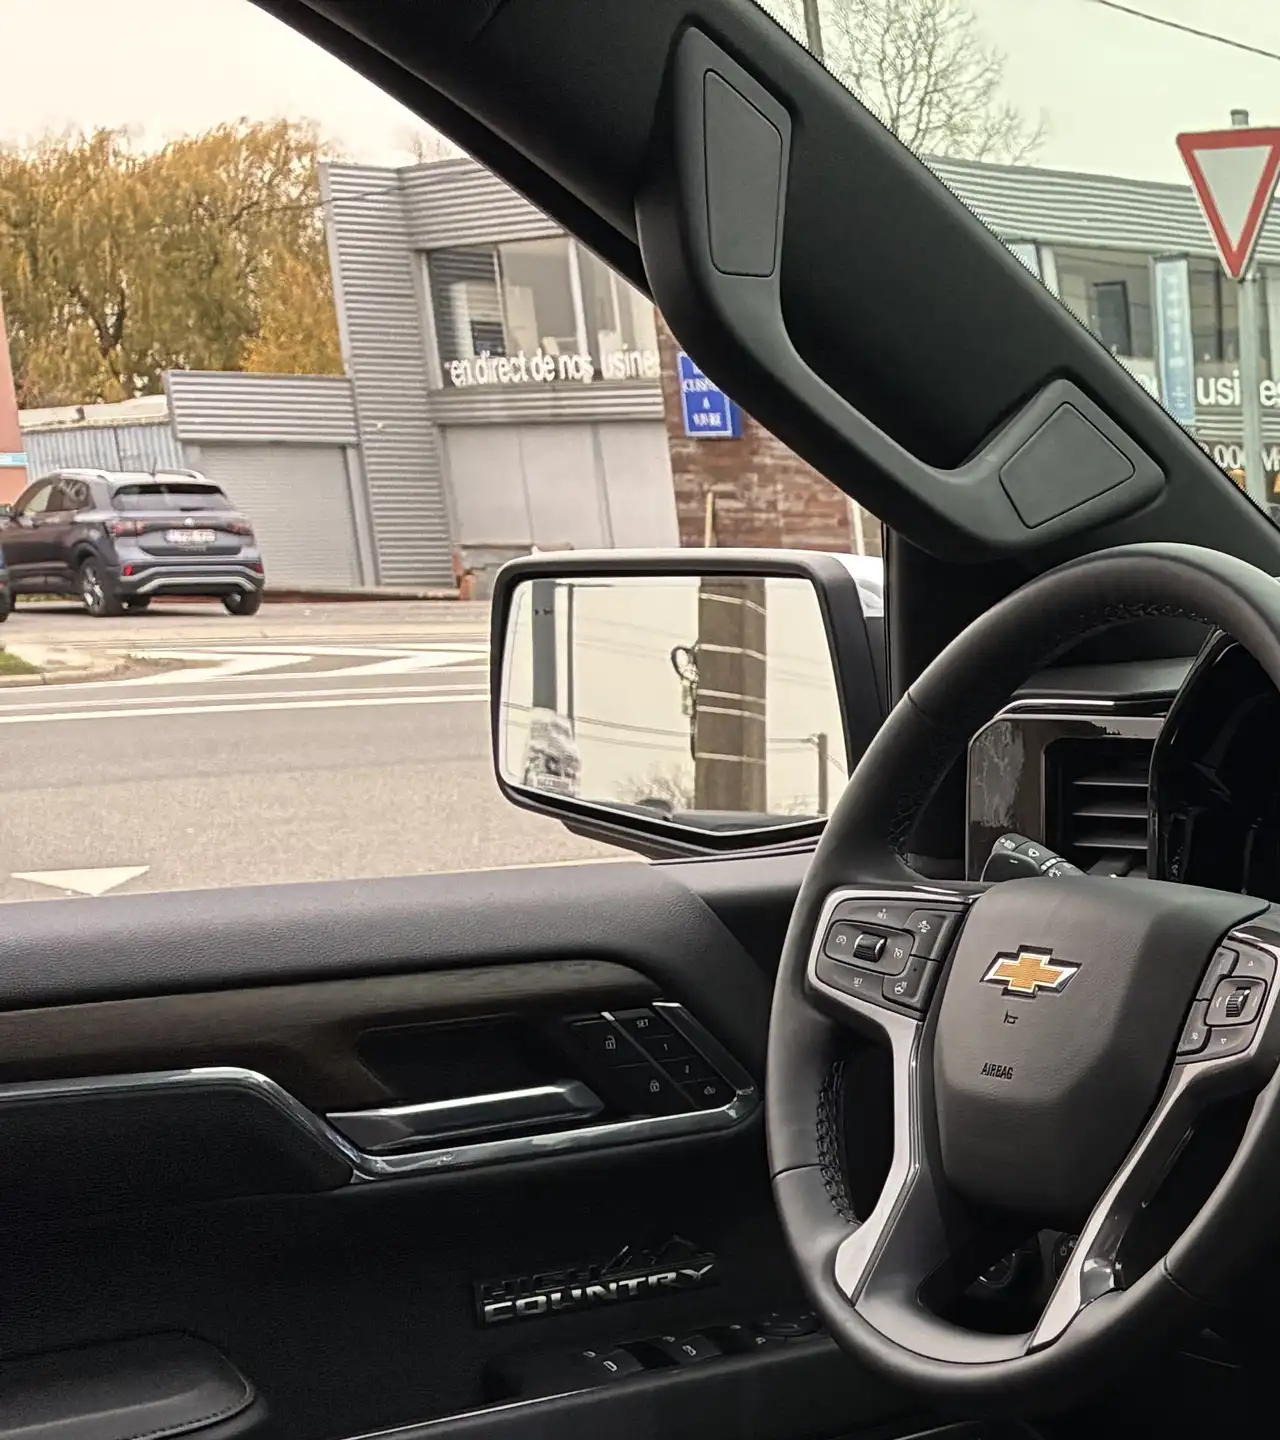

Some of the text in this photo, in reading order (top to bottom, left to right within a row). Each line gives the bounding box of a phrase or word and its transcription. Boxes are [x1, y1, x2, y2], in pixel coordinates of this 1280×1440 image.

[531, 348, 556, 383] de
[980, 1062, 1014, 1081] AIRBAG
[484, 1262, 715, 1324] COUNTRY
